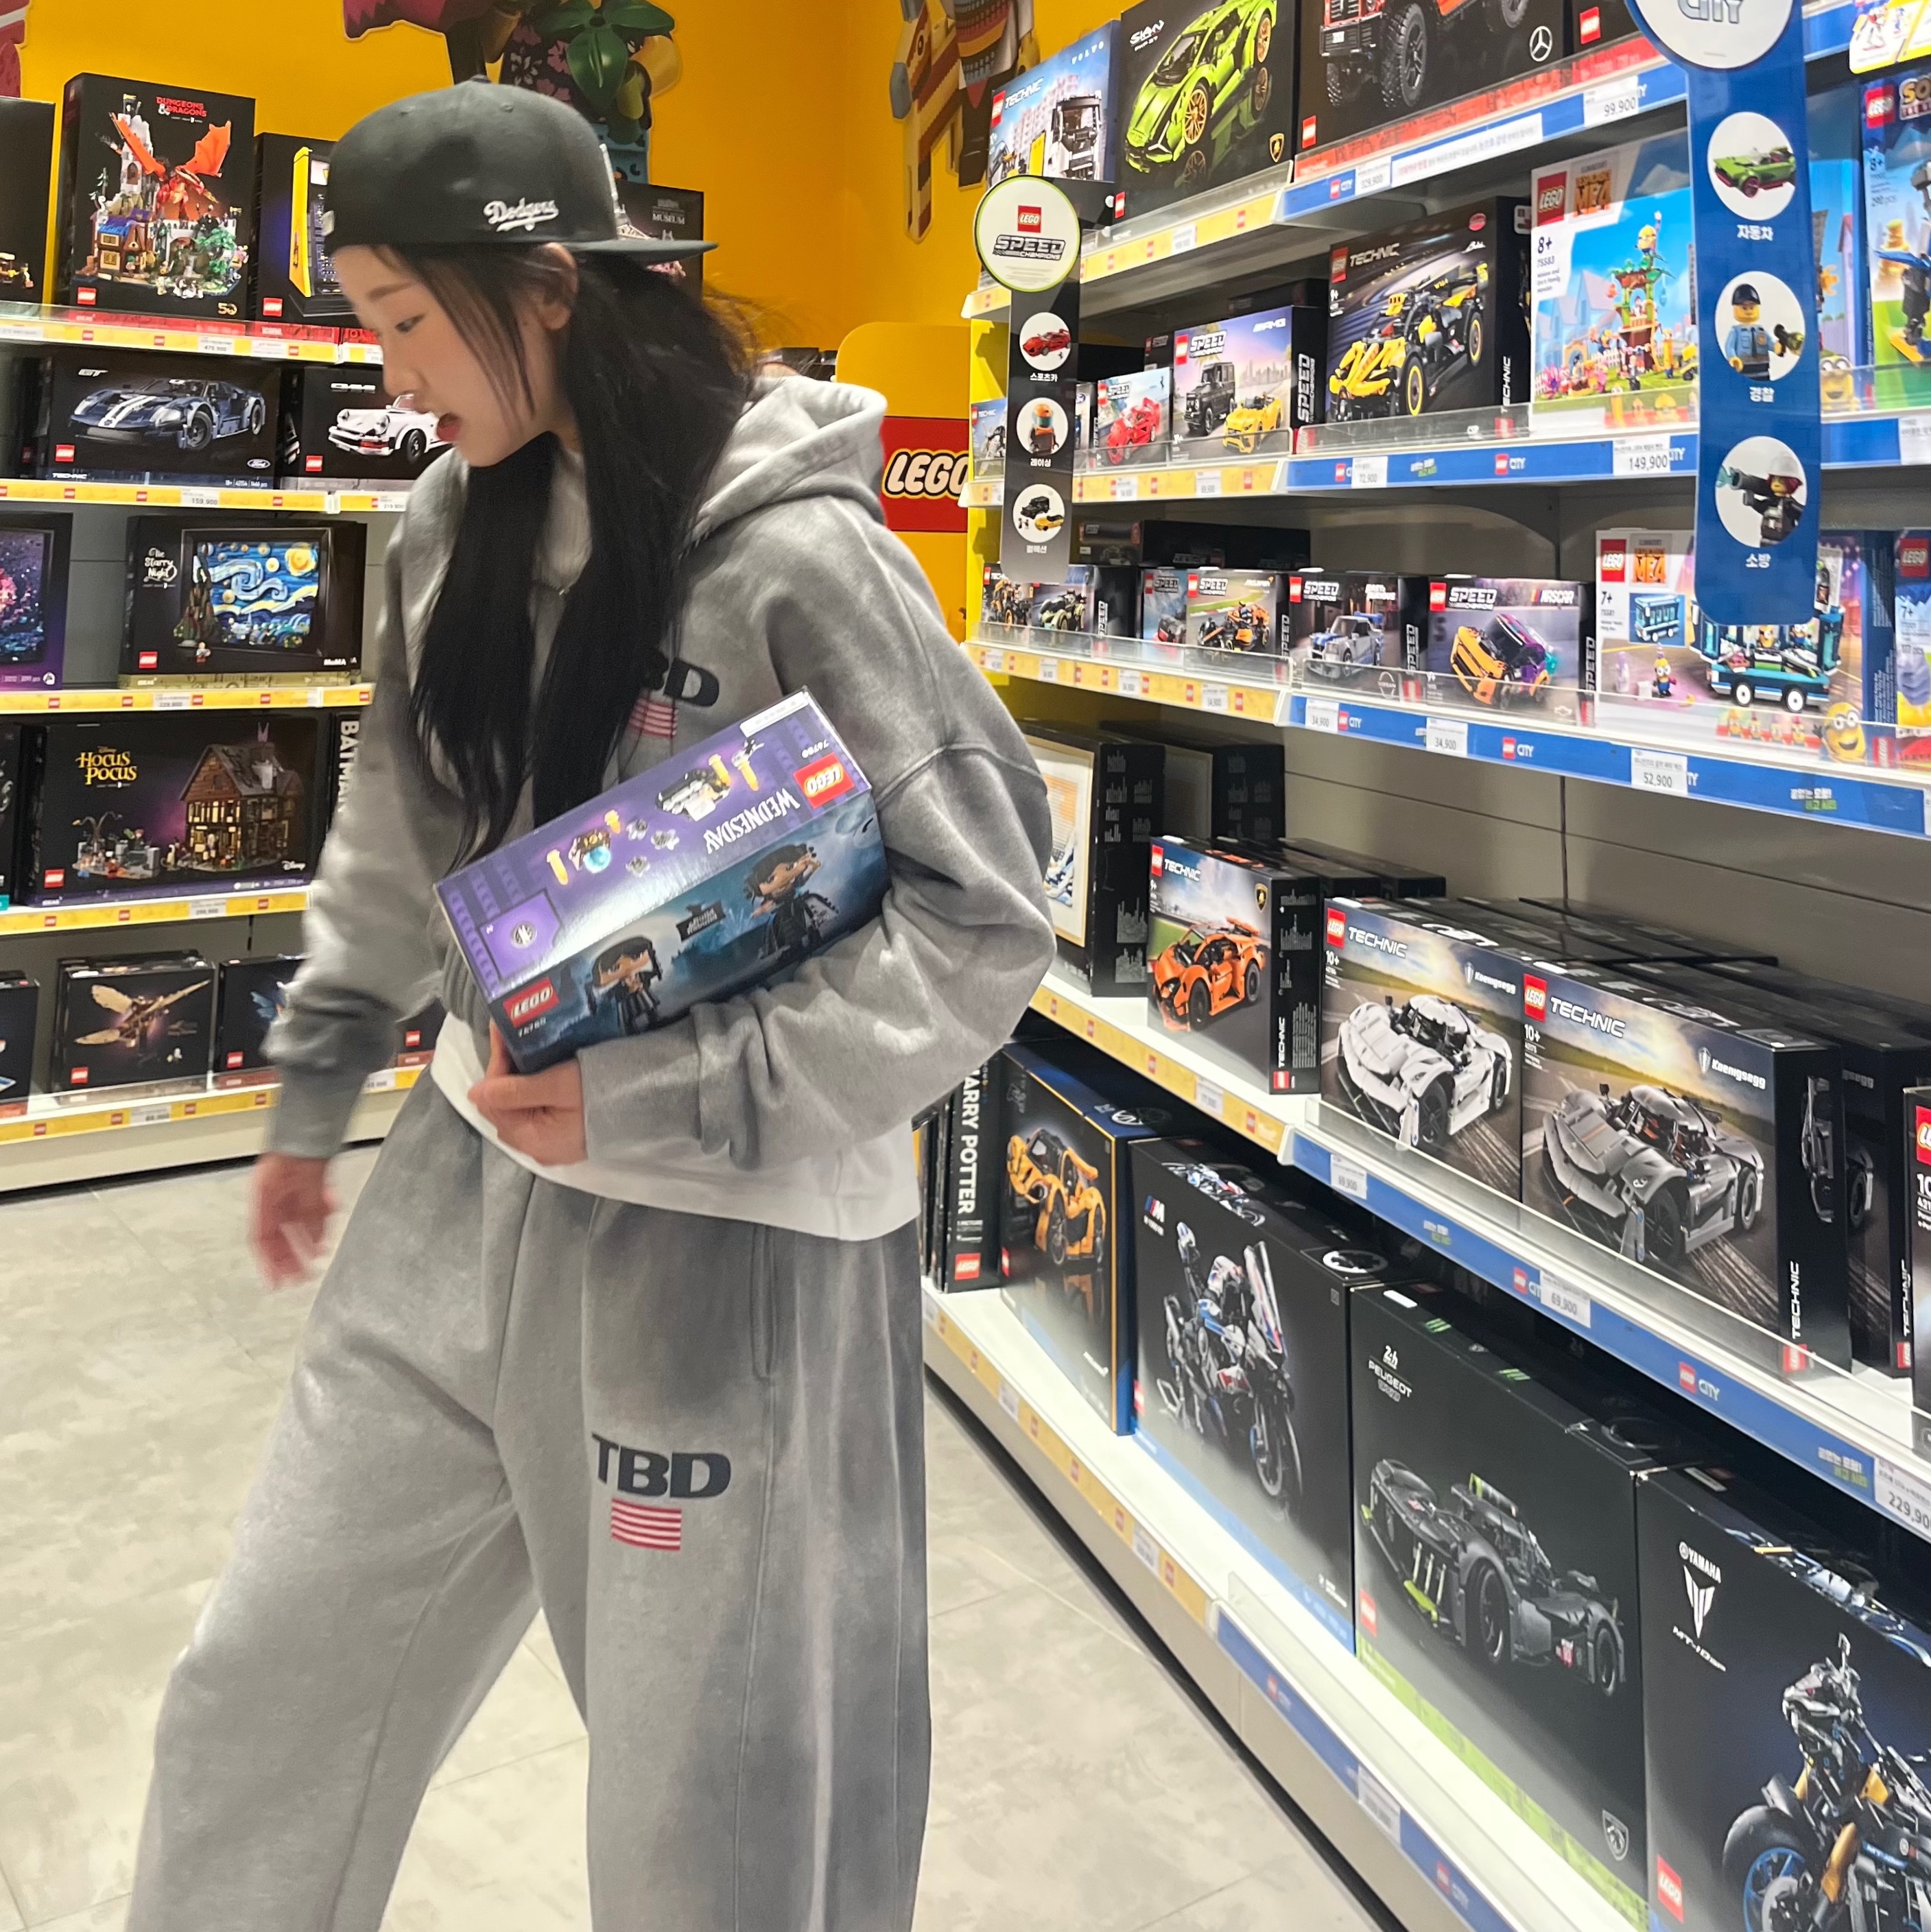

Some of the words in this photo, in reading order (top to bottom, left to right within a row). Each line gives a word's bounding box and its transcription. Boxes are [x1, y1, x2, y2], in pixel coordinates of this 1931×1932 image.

[1071, 40, 1104, 64] VOLVO
[1005, 77, 1043, 109] TECHNIC
[156, 97, 204, 110] DUNGEONS
[169, 107, 206, 117] DRAGONS
[1539, 187, 1564, 212] LEGO
[484, 198, 559, 232] Dodgers
[652, 213, 685, 224] MUSEUM
[1019, 213, 1040, 225] LEGO
[1737, 225, 1773, 241] 자동차
[995, 235, 1066, 254] SPEED
[1538, 237, 1552, 253] 8+
[1019, 251, 1061, 260] CHAMPIONS
[1350, 243, 1400, 266] TECHNIC
[1191, 332, 1226, 350] SPEED
[1030, 373, 1058, 382] 스포츠카
[1298, 354, 1310, 422] SPEED
[1749, 387, 1774, 403] 경찰
[1030, 458, 1052, 467] 레이싱
[1628, 455, 1668, 471] 149,900
[884, 449, 968, 499] LEGO
[145, 556, 174, 568] Starry
[1601, 550, 1624, 571] LEGO
[1746, 553, 1770, 569] 소방
[1902, 549, 1927, 565] LEGO
[147, 566, 170, 579] Night
[1154, 577, 1178, 589] SPEED
[1200, 578, 1228, 590] SPEED
[1304, 583, 1339, 595] SPEED
[1449, 588, 1497, 604] SPEED
[1540, 591, 1574, 604] NASCAR
[1601, 591, 1613, 605] 7+
[1434, 737, 1456, 751] 34,900
[1517, 743, 1534, 757] CITY
[76, 752, 130, 770] HOCUS
[338, 720, 360, 812] BATMAN
[84, 765, 137, 786] POCUS
[803, 763, 844, 796] LEGO
[1644, 773, 1672, 788] 52,900
[704, 787, 801, 854] WEDNESDAY
[282, 861, 306, 871] Disney
[1164, 858, 1201, 882] TECHNIC
[1328, 920, 1344, 937] LEGO
[1349, 926, 1408, 958] TECHNIC
[1326, 951, 1340, 966] 10+
[1474, 972, 1516, 995] Koenigsegg
[511, 988, 553, 1019] LEGO
[1525, 988, 1545, 1007] LEGO
[1550, 997, 1625, 1038] TECHNIC
[1525, 1025, 1541, 1042] 10+
[1711, 1058, 1766, 1089] Koenigsegg
[958, 1134, 978, 1214] POTTER
[1791, 1261, 1800, 1339] TECHNIC
[1368, 1359, 1412, 1398] PEUGEOT
[1698, 1380, 1720, 1400] CITY
[591, 1432, 731, 1498] TBD
[1688, 1548, 1722, 1584] YAMAHA
[1659, 1874, 1682, 1904] LEGO
